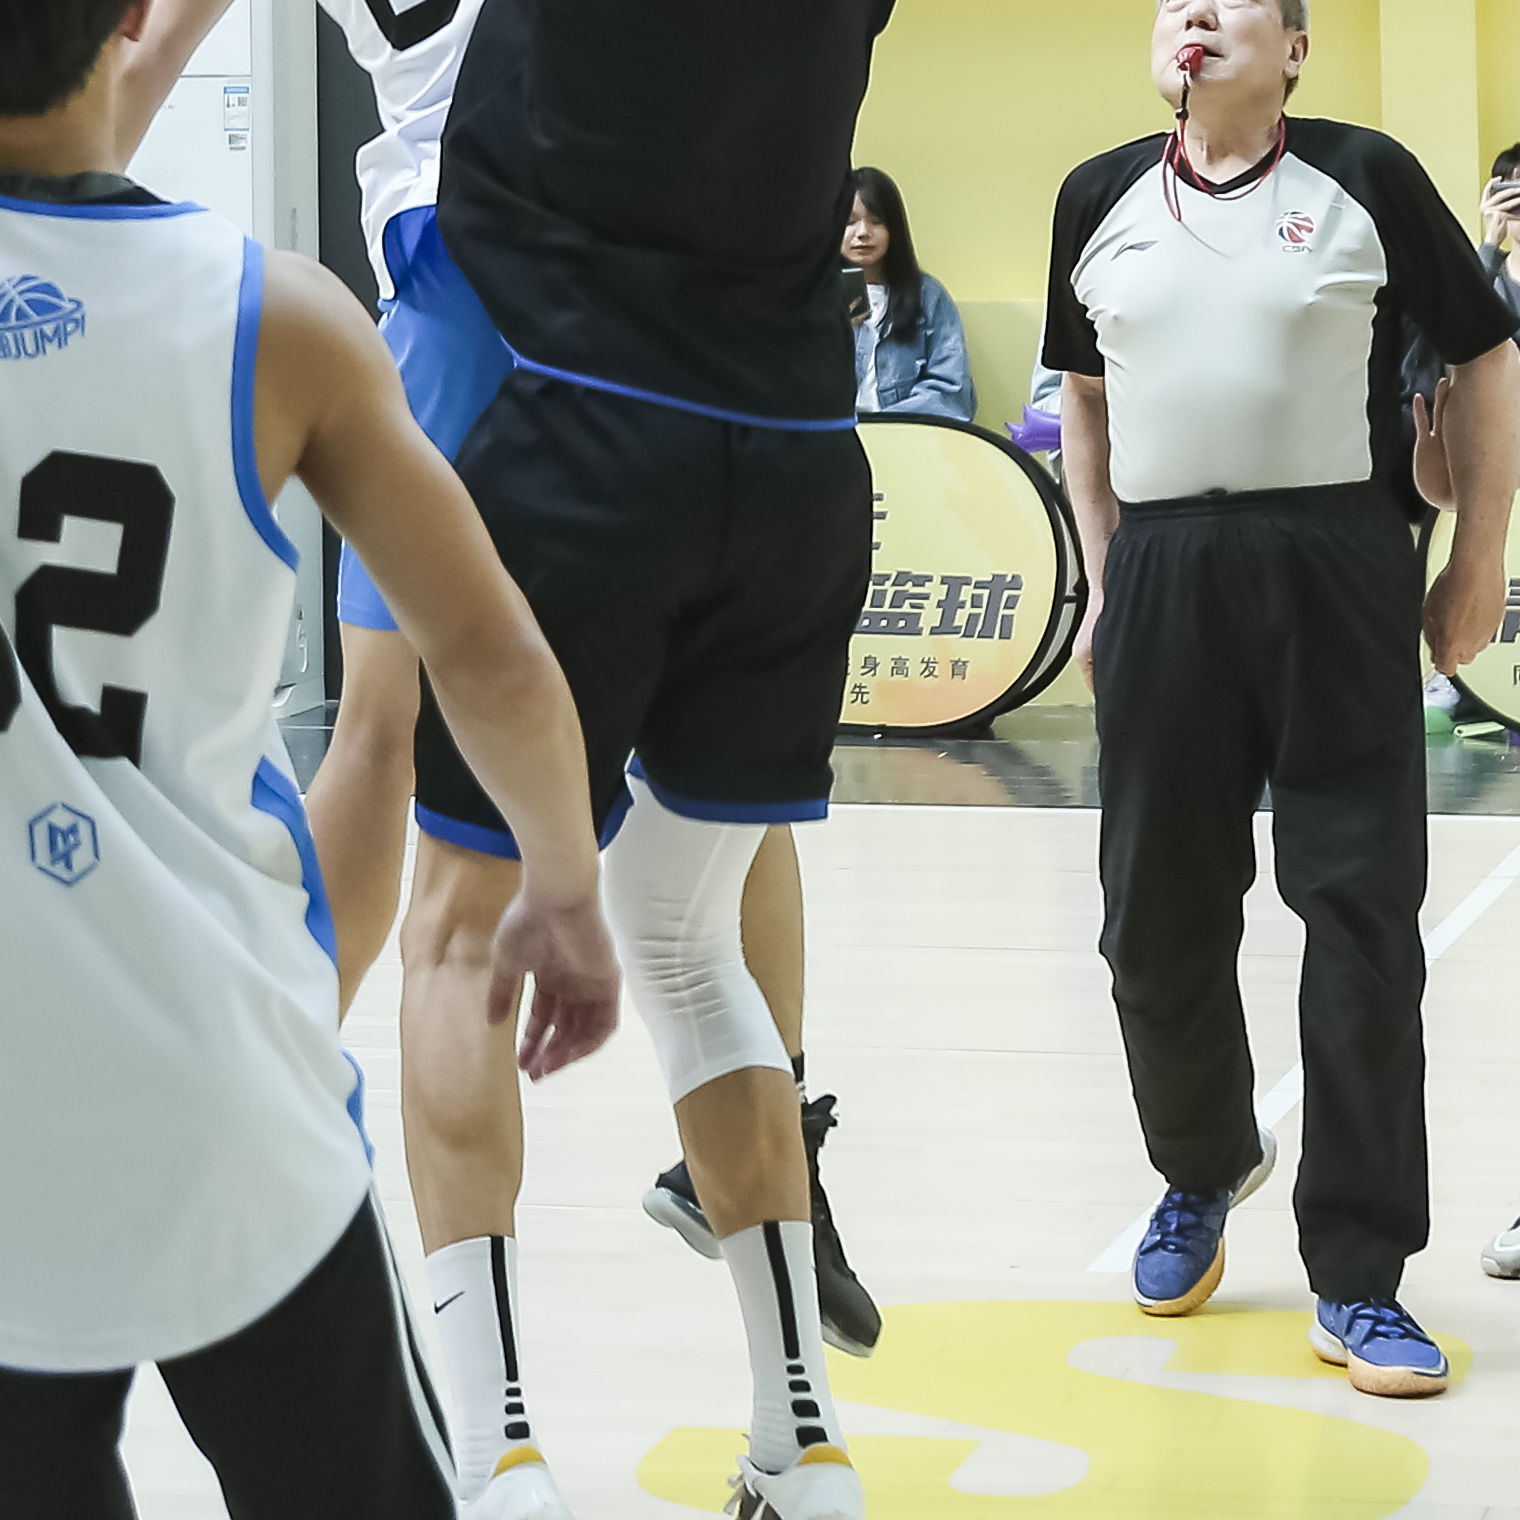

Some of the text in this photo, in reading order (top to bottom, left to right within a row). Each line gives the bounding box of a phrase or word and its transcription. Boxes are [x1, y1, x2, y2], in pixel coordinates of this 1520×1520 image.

[855, 571, 1023, 640] 篮球
[847, 654, 970, 681] 身高发育
